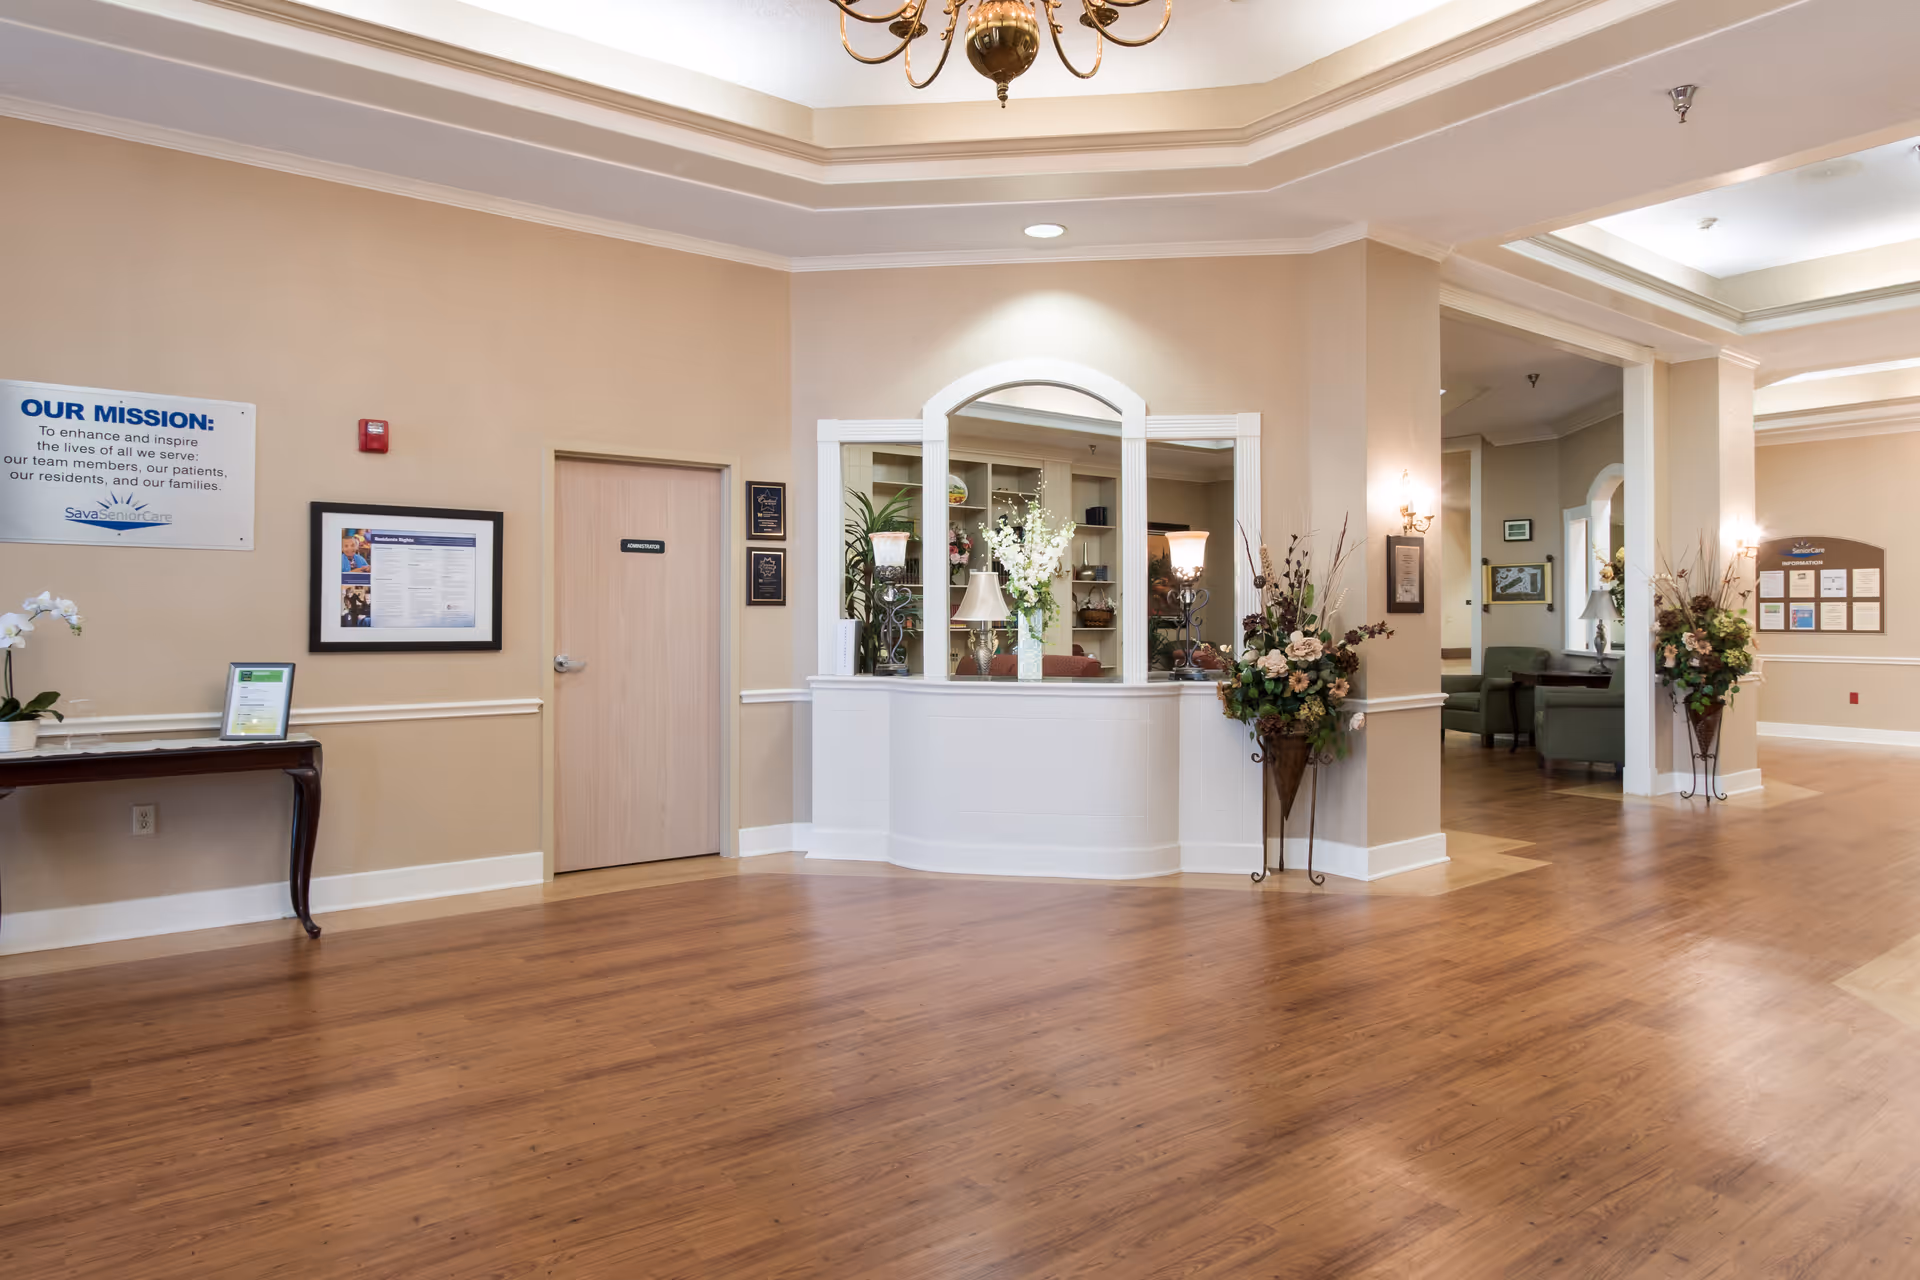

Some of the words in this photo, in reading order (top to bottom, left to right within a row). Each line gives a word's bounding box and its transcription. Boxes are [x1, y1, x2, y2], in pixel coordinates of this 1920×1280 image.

[21, 399, 85, 420] OUR
[94, 404, 214, 431] MISSION:
[39, 425, 55, 437] To
[60, 428, 120, 441] enhance
[124, 432, 150, 443] and
[154, 434, 198, 448] inspire
[37, 441, 59, 452] the
[64, 442, 95, 454] lives
[100, 446, 113, 456] of
[117, 447, 132, 457] all
[137, 450, 155, 458] we
[160, 451, 199, 462] serve:
[4, 455, 28, 465] our
[33, 456, 68, 467] team
[73, 459, 142, 474] members,
[147, 464, 168, 474] our
[173, 466, 228, 479] patients,
[10, 471, 34, 480] our
[39, 472, 108, 487] residents,
[113, 476, 138, 486] and
[143, 479, 165, 488] our
[169, 478, 222, 491] families.
[65, 506, 172, 522] SavaSeniorCare
